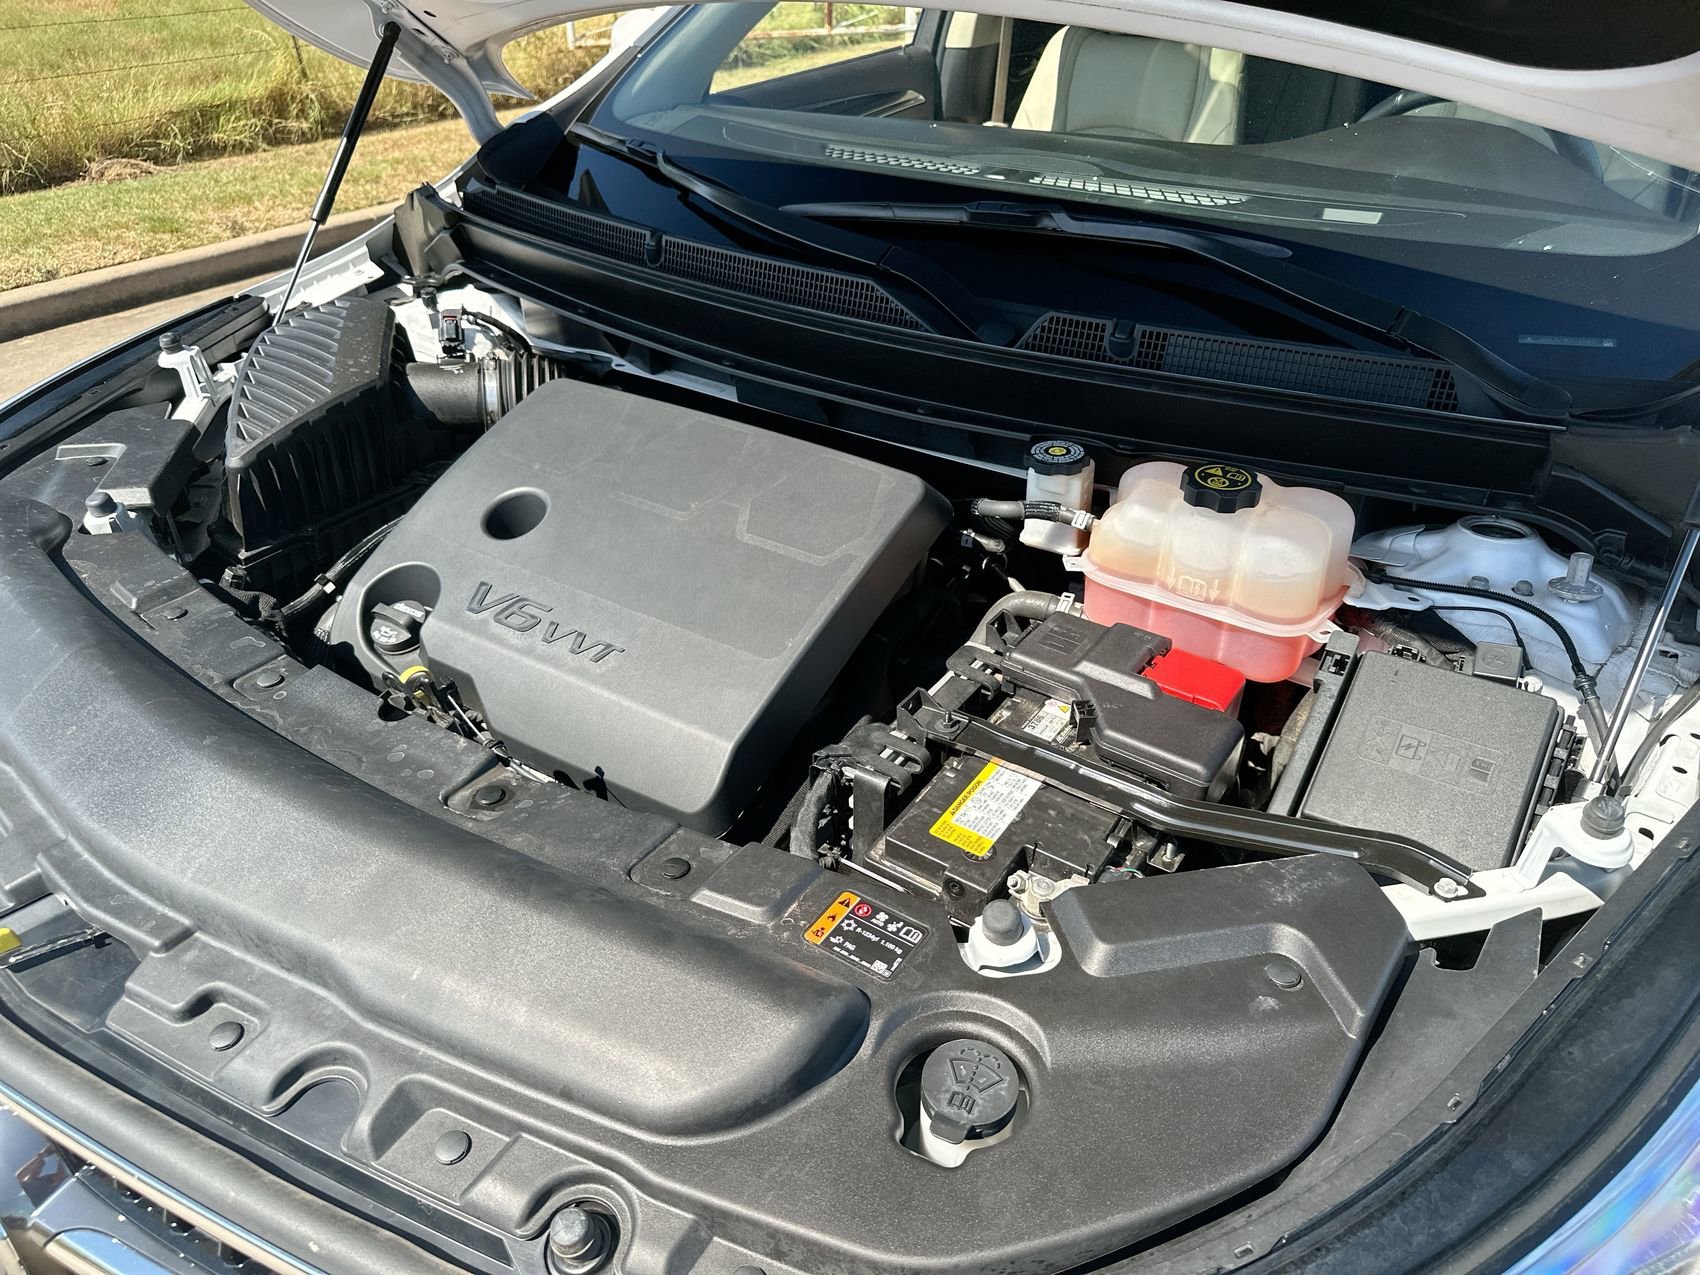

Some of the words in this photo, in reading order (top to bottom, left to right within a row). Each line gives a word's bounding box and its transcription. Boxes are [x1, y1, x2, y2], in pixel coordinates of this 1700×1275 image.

[393, 603, 424, 617] dexos
[467, 581, 553, 632] V6
[541, 621, 625, 663] VVT
[843, 941, 856, 951] PAG
